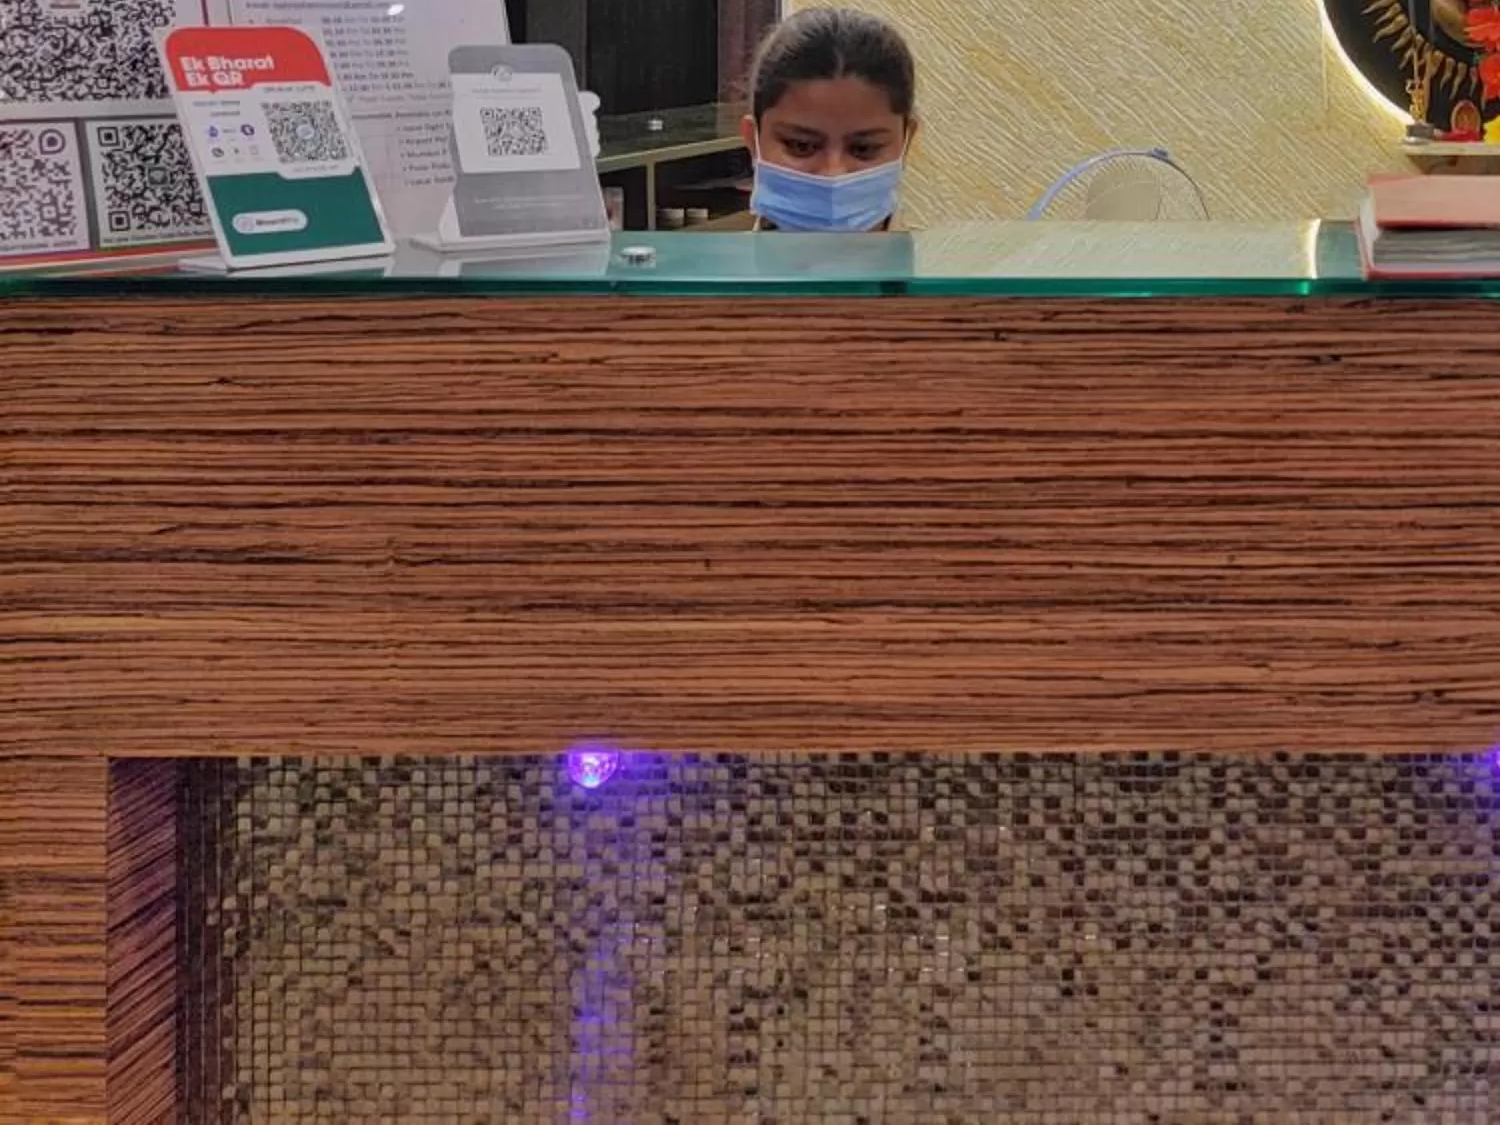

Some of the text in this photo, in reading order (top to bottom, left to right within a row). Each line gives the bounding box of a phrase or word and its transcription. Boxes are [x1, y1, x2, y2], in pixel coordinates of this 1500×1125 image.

[180, 53, 275, 72] Ek Bharat
[186, 71, 244, 87] Ek QR
